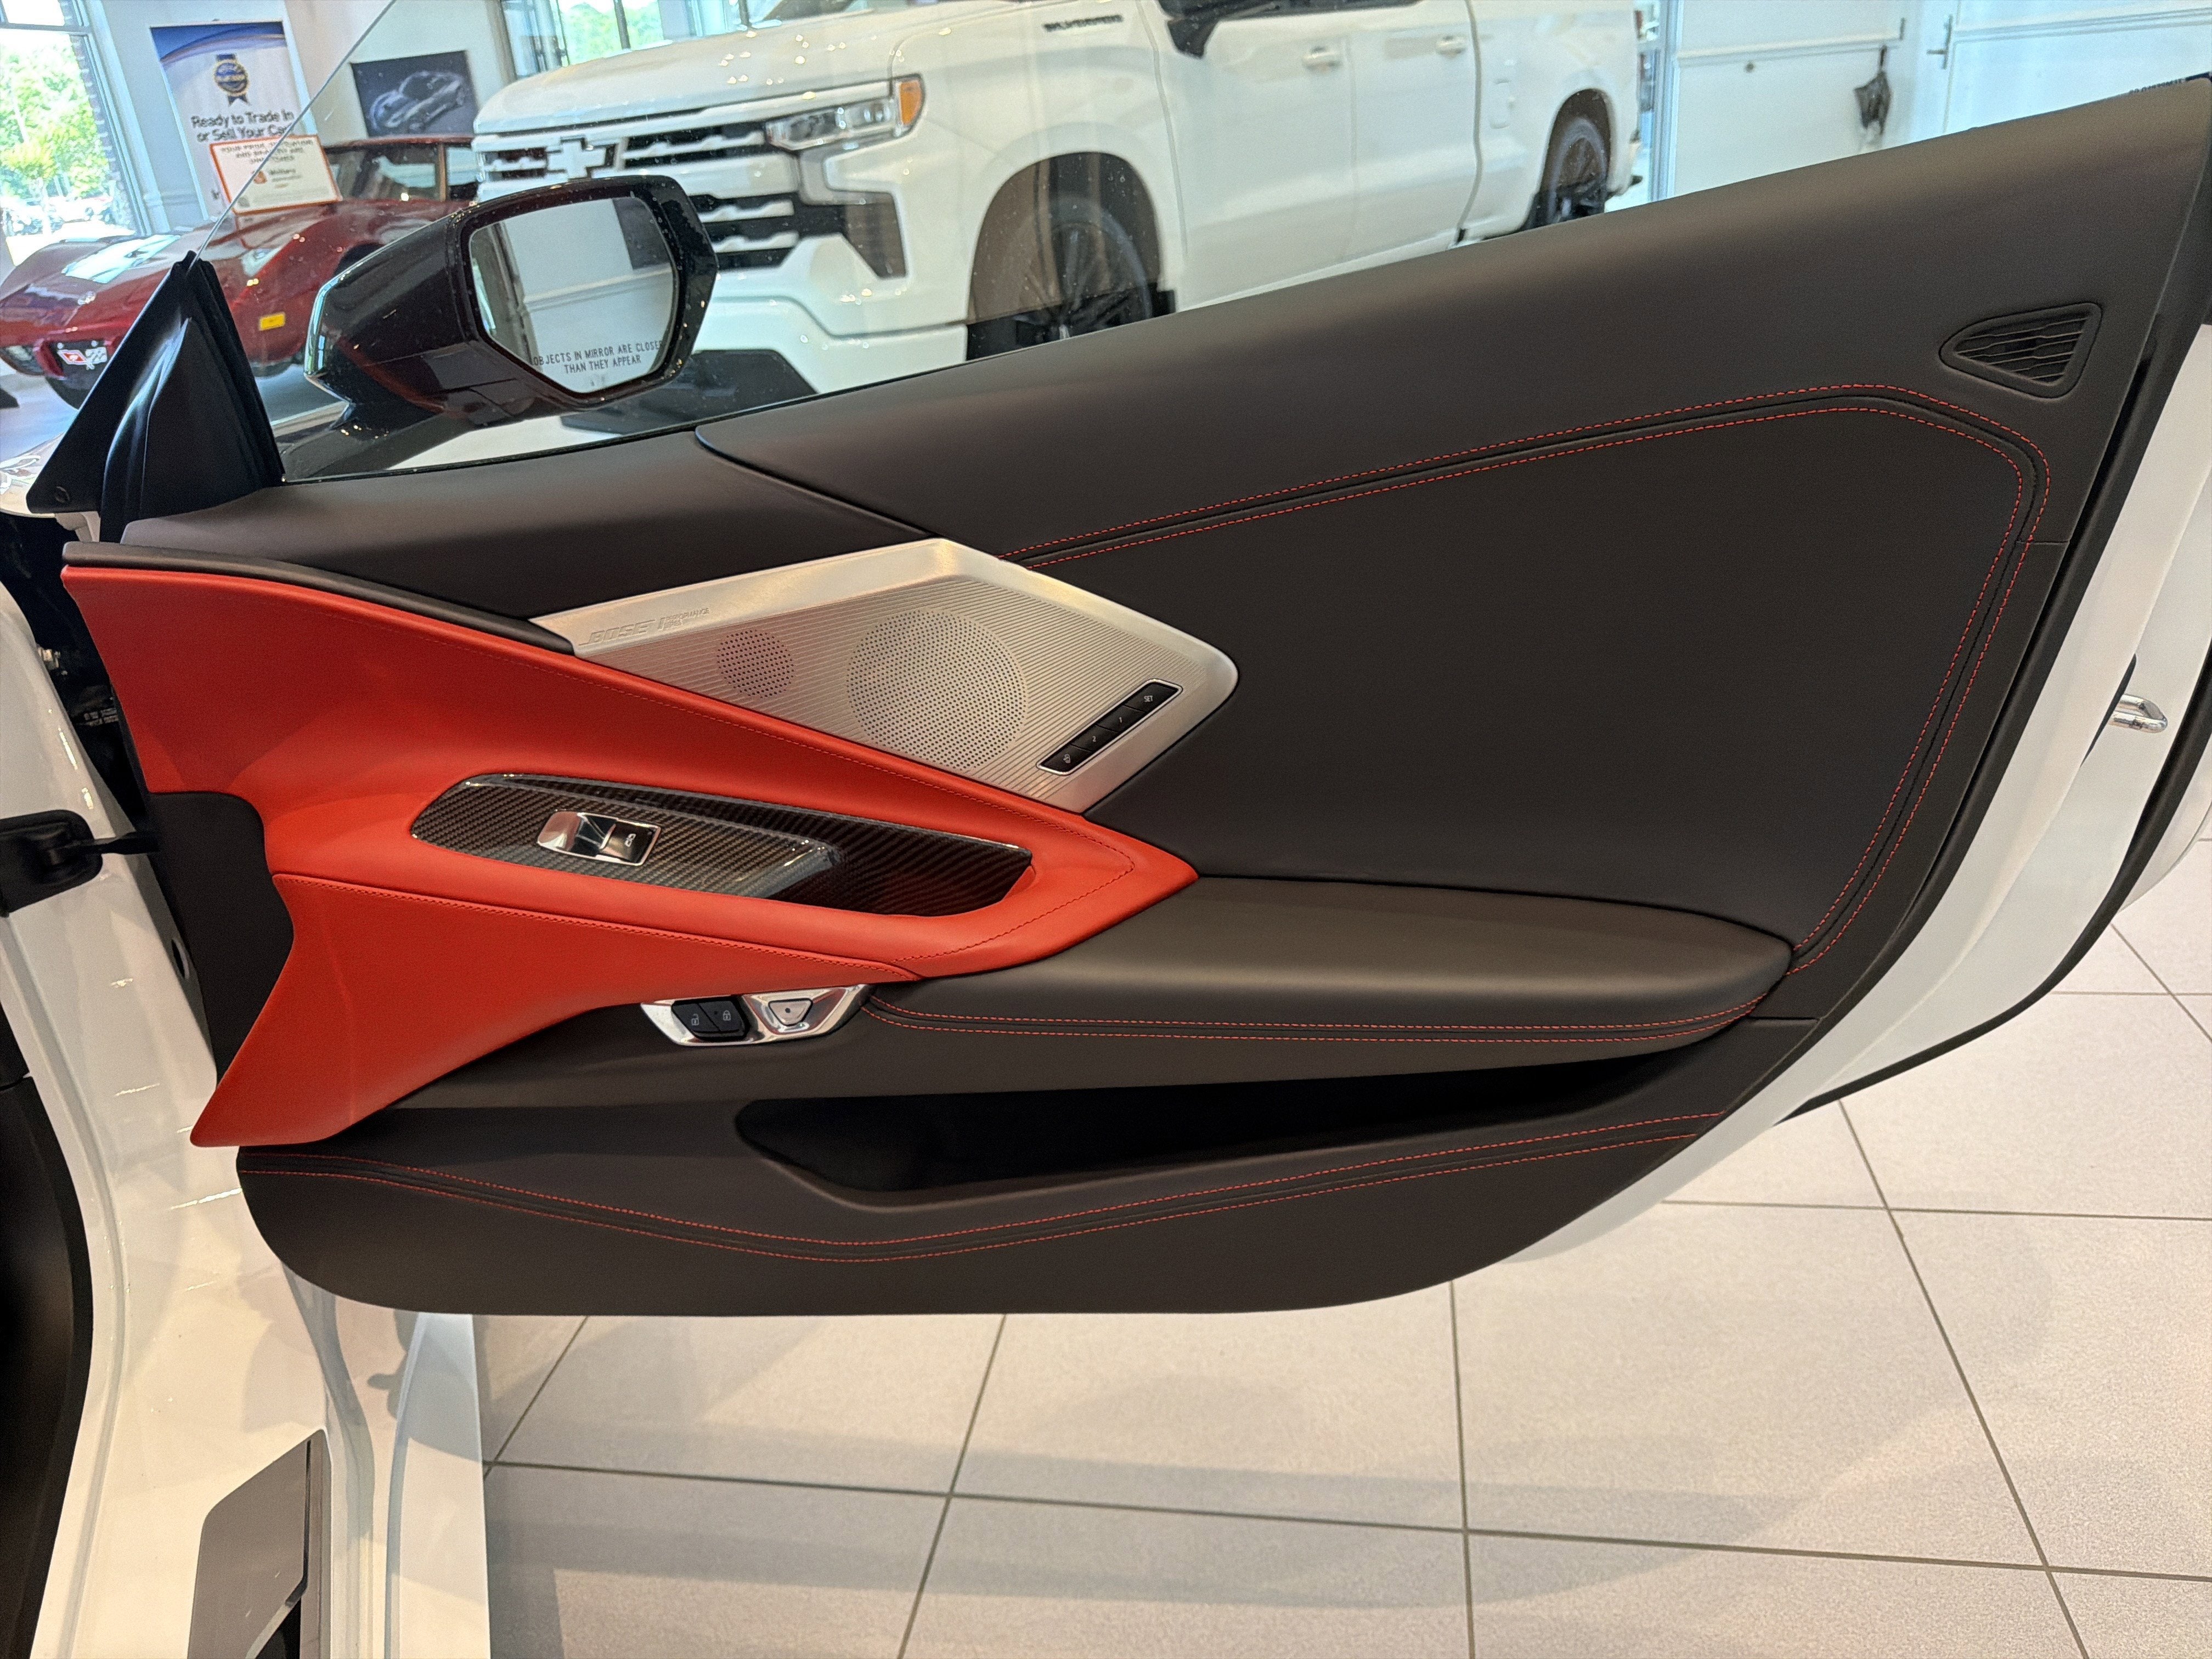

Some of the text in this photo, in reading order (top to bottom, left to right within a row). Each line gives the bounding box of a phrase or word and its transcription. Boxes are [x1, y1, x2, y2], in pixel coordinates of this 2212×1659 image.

[191, 109, 294, 129] Ready to Trade In
[197, 132, 209, 143] or
[212, 127, 236, 141] Sell
[237, 126, 264, 138] Your
[533, 352, 572, 366] OBJECTS
[574, 350, 583, 360] IN
[584, 346, 614, 359] MIRROR
[618, 343, 633, 354] ARE
[564, 354, 642, 374] THAN THEY APPEAR
